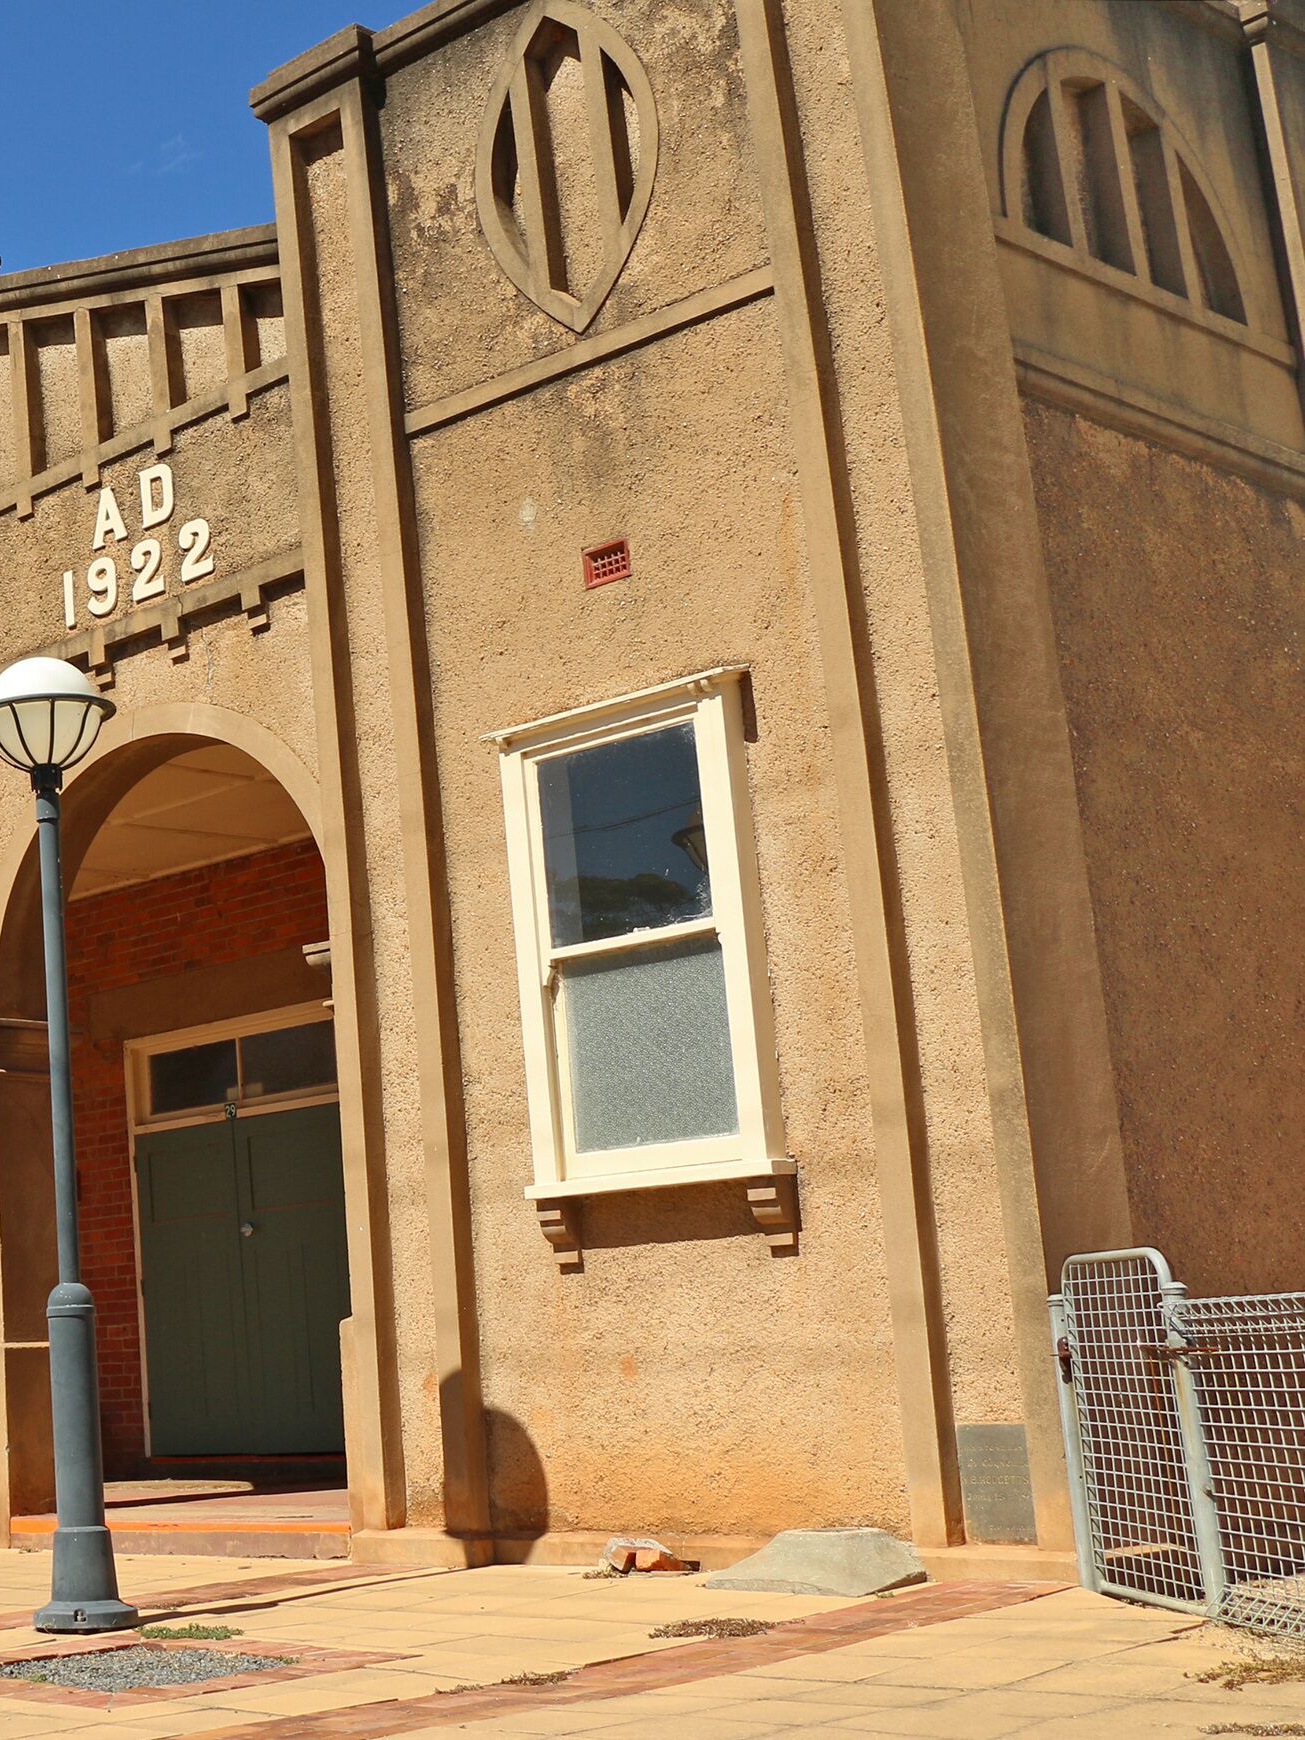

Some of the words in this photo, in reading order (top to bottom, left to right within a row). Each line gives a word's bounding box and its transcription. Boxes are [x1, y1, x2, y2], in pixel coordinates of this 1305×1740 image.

[92, 463, 174, 550] AD
[63, 518, 215, 629] 1922
[225, 1104, 236, 1118] 29
